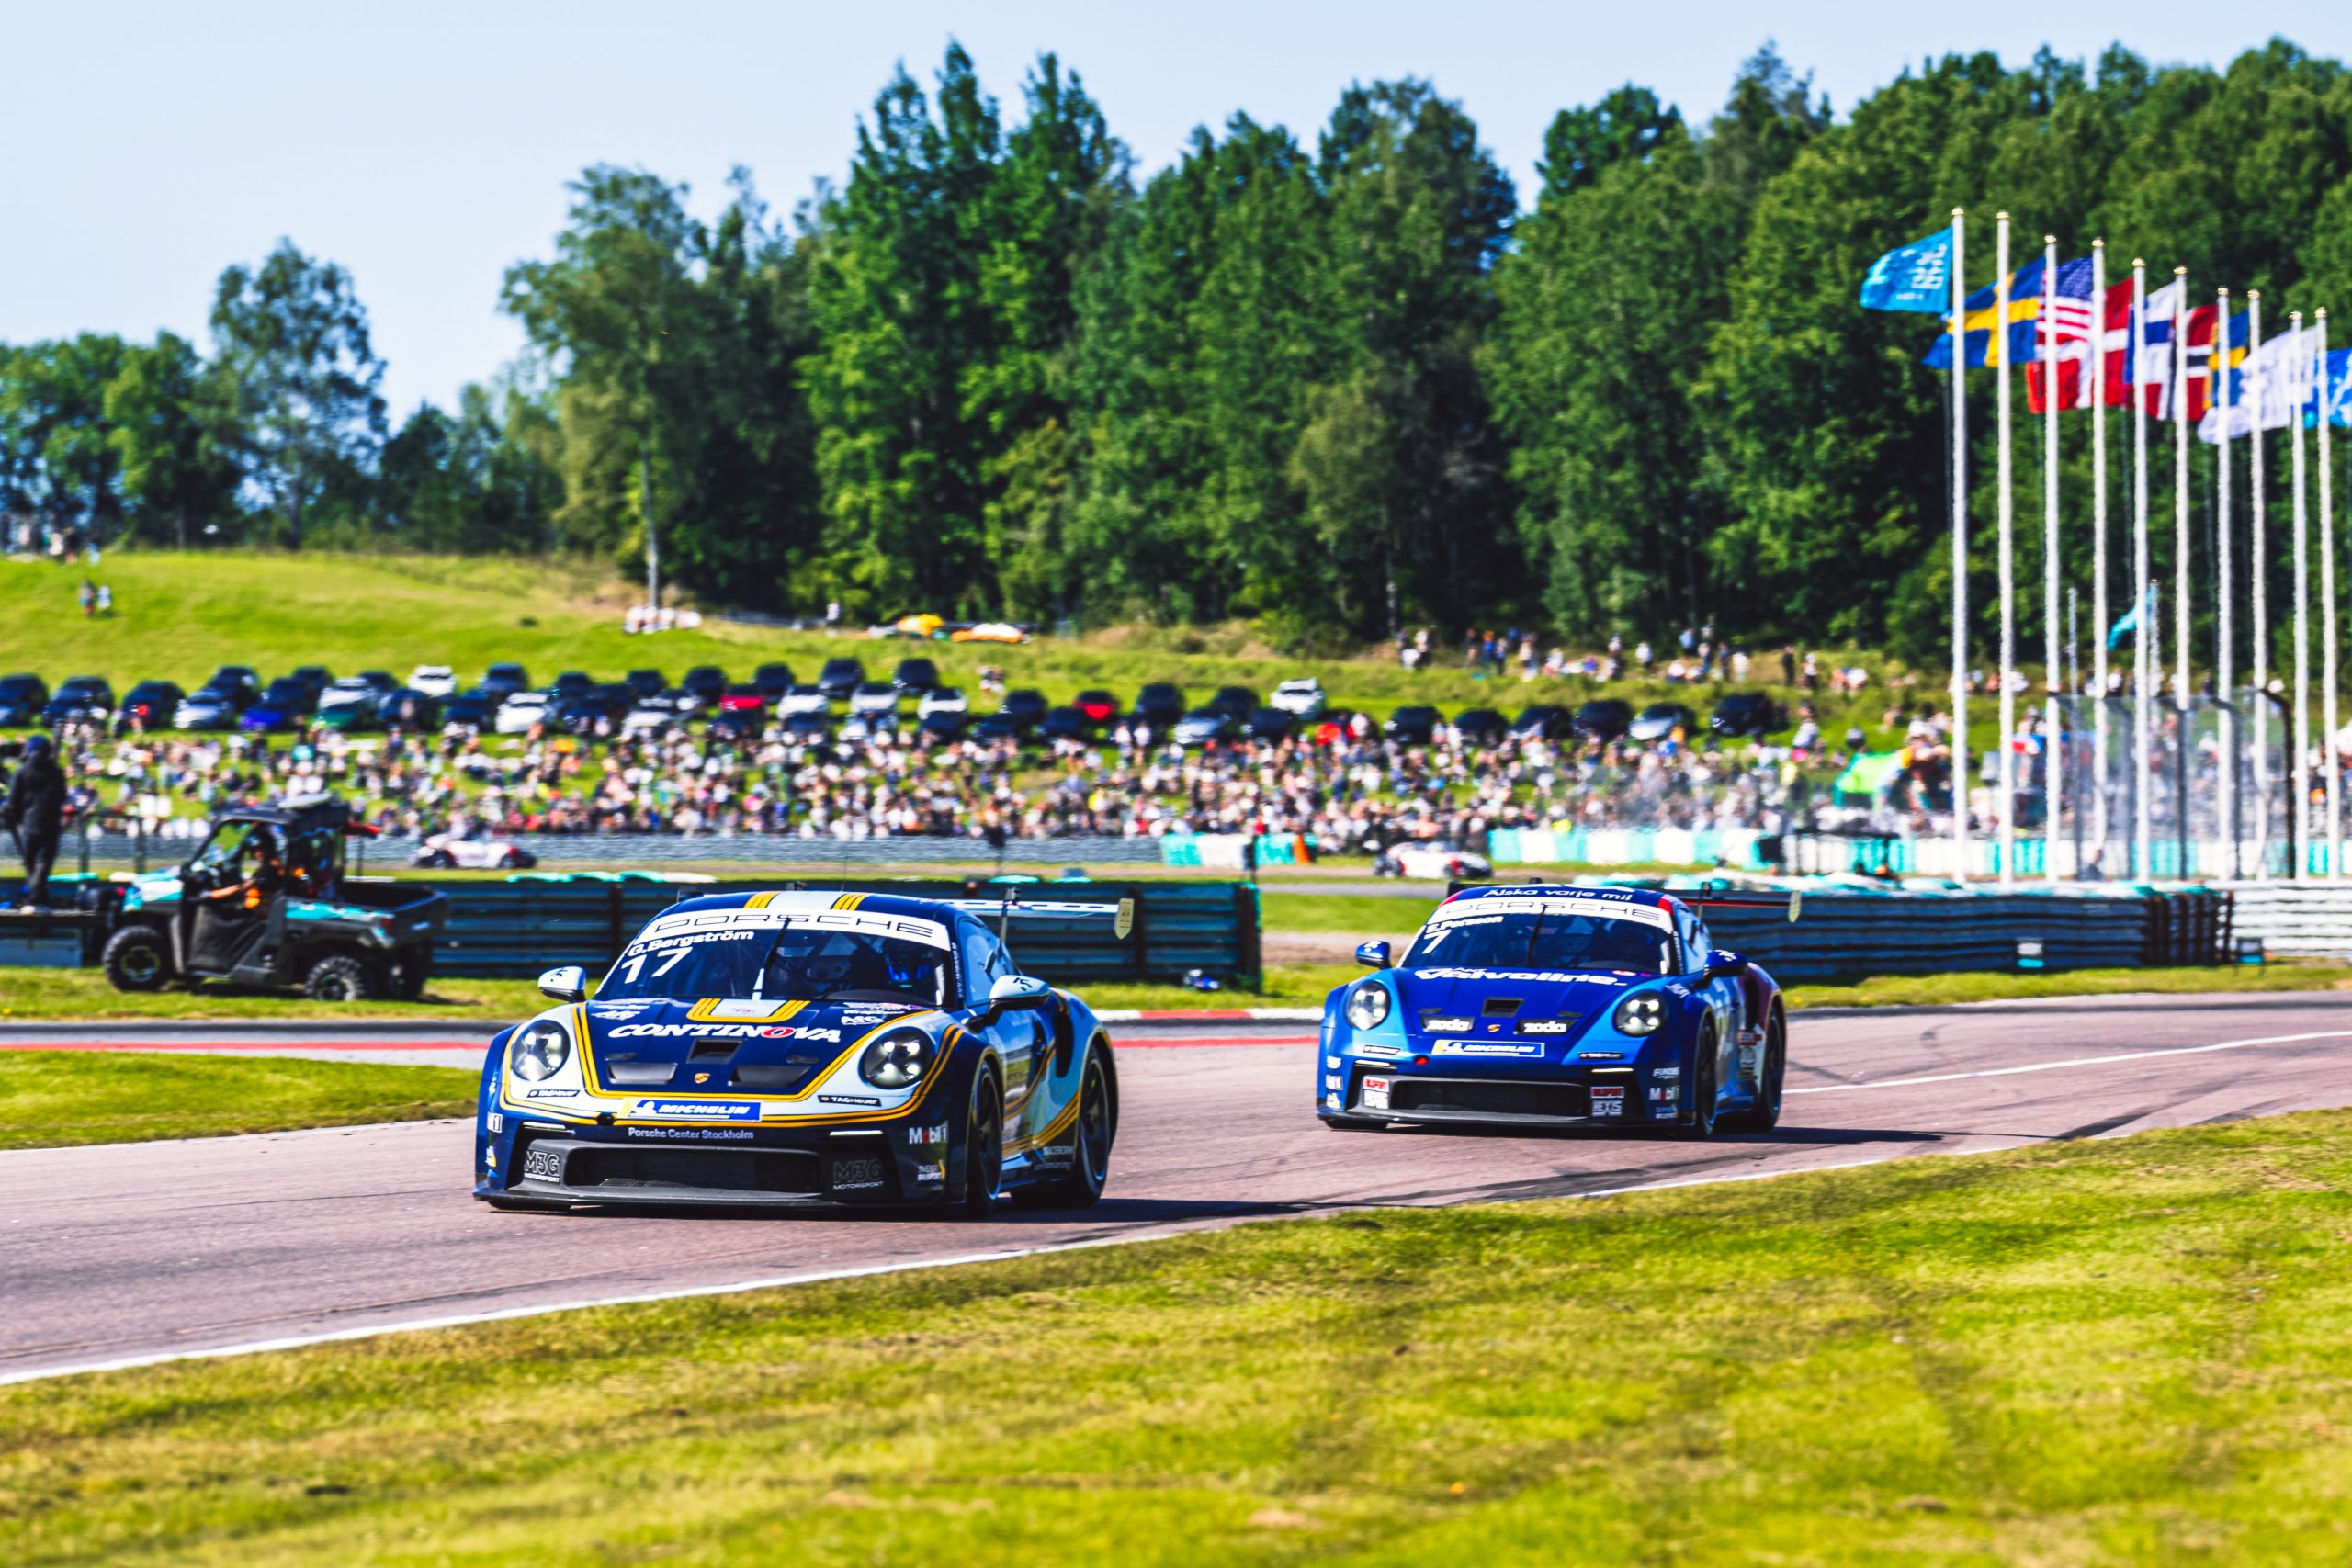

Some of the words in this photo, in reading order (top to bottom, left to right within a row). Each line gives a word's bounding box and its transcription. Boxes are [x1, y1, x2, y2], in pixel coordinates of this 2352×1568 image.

[1482, 888, 1539, 897] Älska
[1544, 889, 1596, 898] varje
[1601, 892, 1634, 901] mil
[1445, 901, 1660, 921] PORSCHE
[655, 914, 933, 939] PORSCHE
[1425, 915, 1505, 935] E.Persson
[628, 930, 755, 958] G.Bergström
[1420, 928, 1452, 955] 7
[621, 946, 694, 985] 17
[1414, 969, 1619, 986] Valvoline
[607, 1022, 842, 1043] CONTINOVA
[1427, 1018, 1471, 1032] zoda
[1522, 1021, 1567, 1033] zoda
[657, 1104, 752, 1115] MICHELIN
[628, 1126, 667, 1139] Porsche
[667, 1128, 700, 1140] Center
[701, 1129, 755, 1141] Stockholm
[909, 1125, 942, 1145] Mobil
[523, 1150, 560, 1177] M3G
[832, 1158, 884, 1184] M3G
[832, 1181, 885, 1190] MOTORSPORT
